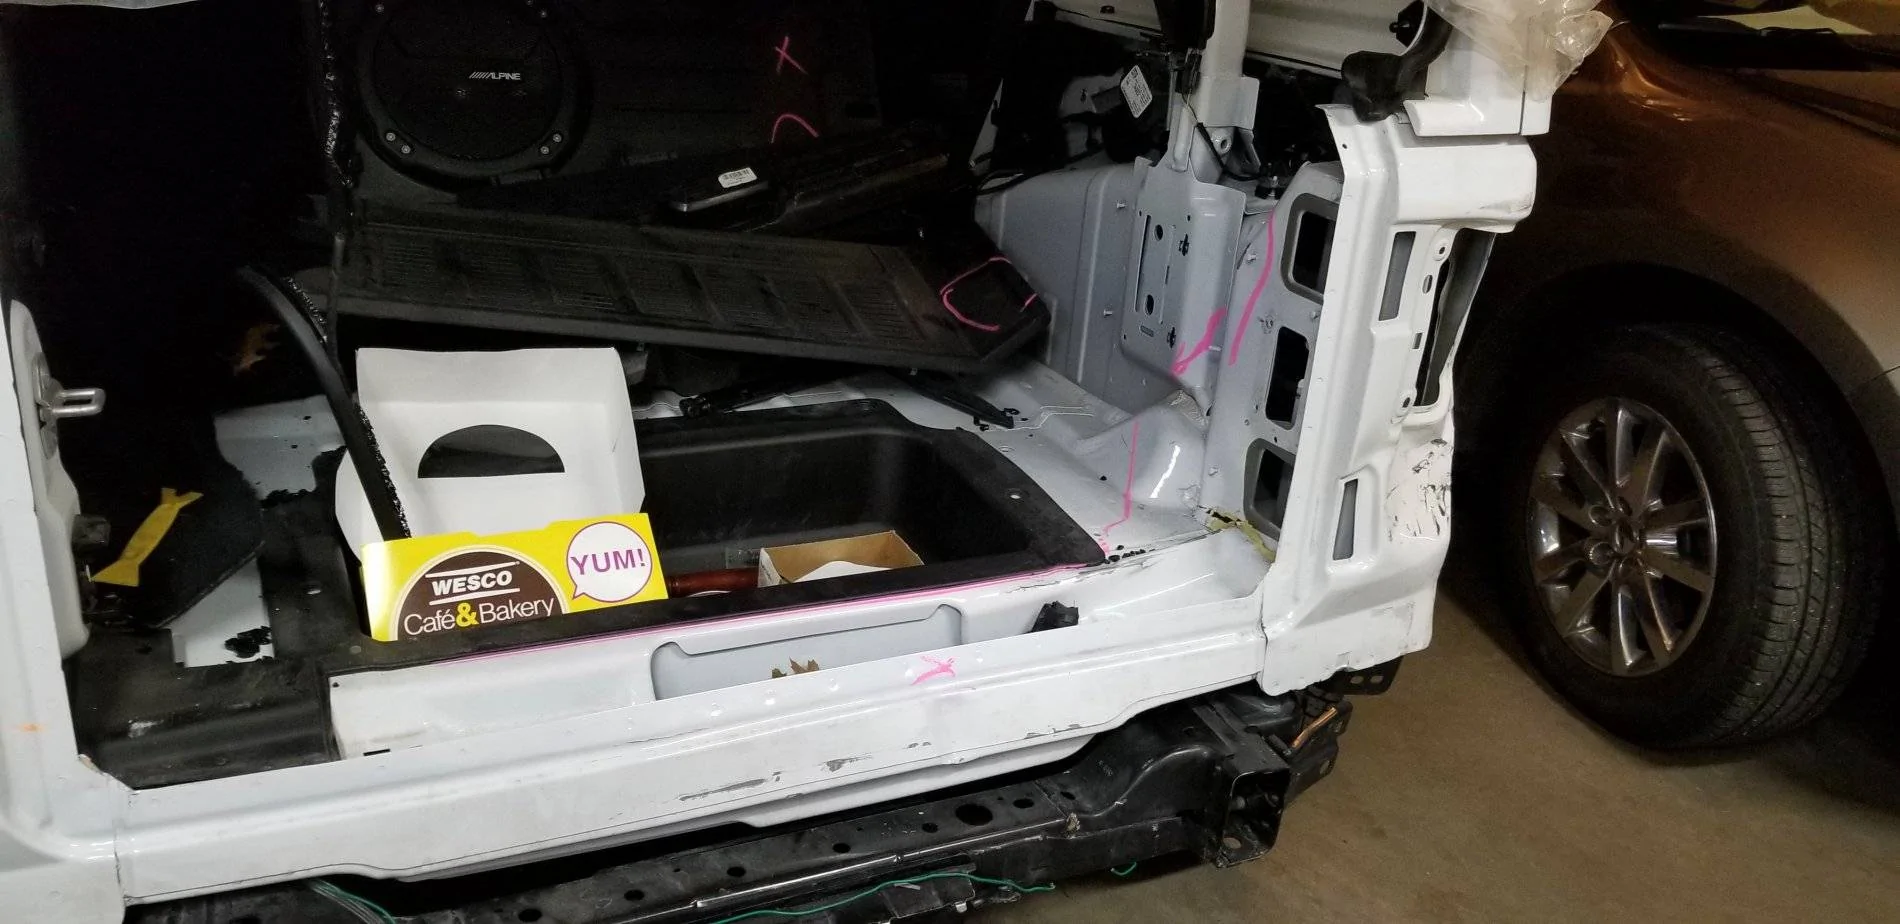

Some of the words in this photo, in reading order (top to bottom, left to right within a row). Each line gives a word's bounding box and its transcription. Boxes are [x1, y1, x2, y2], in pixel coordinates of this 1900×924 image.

[485, 71, 521, 80] ALPINE
[570, 548, 645, 576] YUM!
[431, 570, 513, 596] WESCO
[478, 597, 554, 624] Bakery
